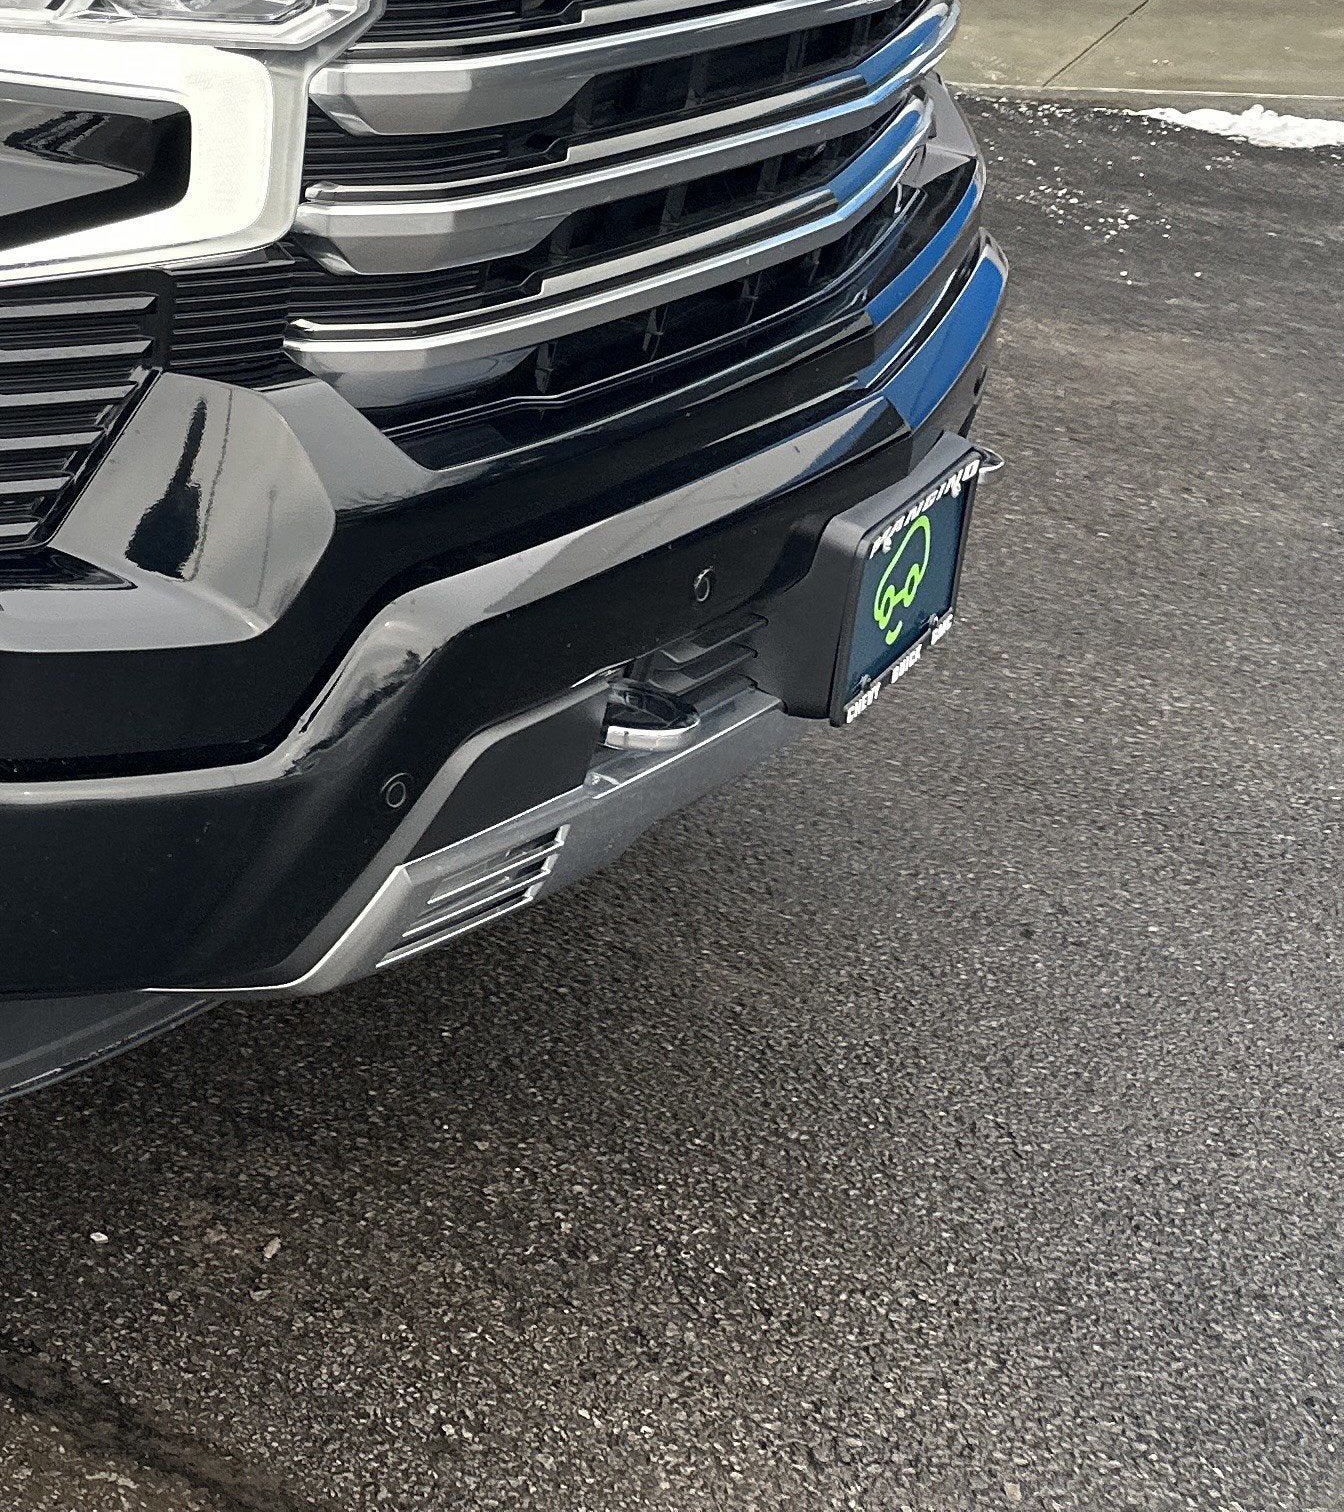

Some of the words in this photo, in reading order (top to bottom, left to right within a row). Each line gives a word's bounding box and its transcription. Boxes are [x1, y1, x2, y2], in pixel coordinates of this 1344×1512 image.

[869, 459, 980, 560] MANGINO
[846, 681, 882, 724] CHEVY
[890, 643, 923, 684] BUICK
